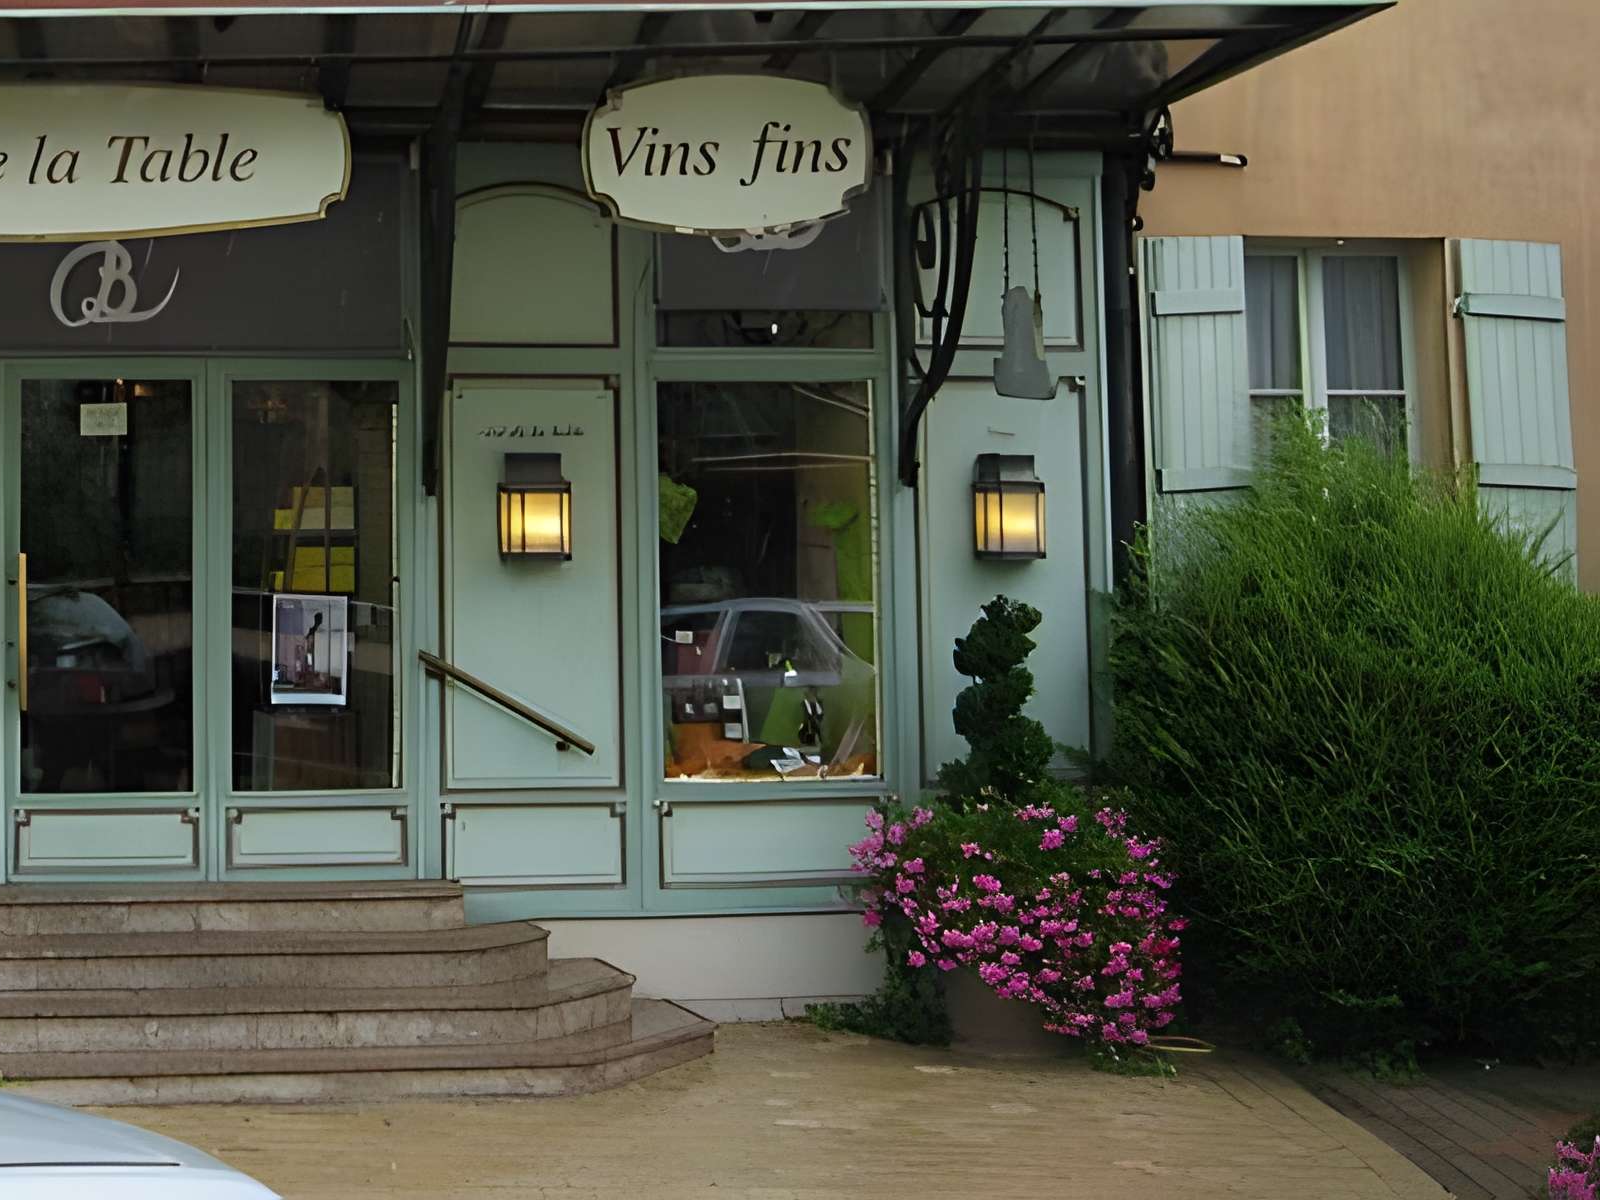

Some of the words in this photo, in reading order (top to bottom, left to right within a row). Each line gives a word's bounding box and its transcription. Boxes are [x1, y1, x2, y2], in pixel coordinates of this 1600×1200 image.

[26, 134, 81, 186] la
[106, 132, 260, 184] Table
[606, 125, 720, 177] Vins
[739, 120, 852, 187] fins
